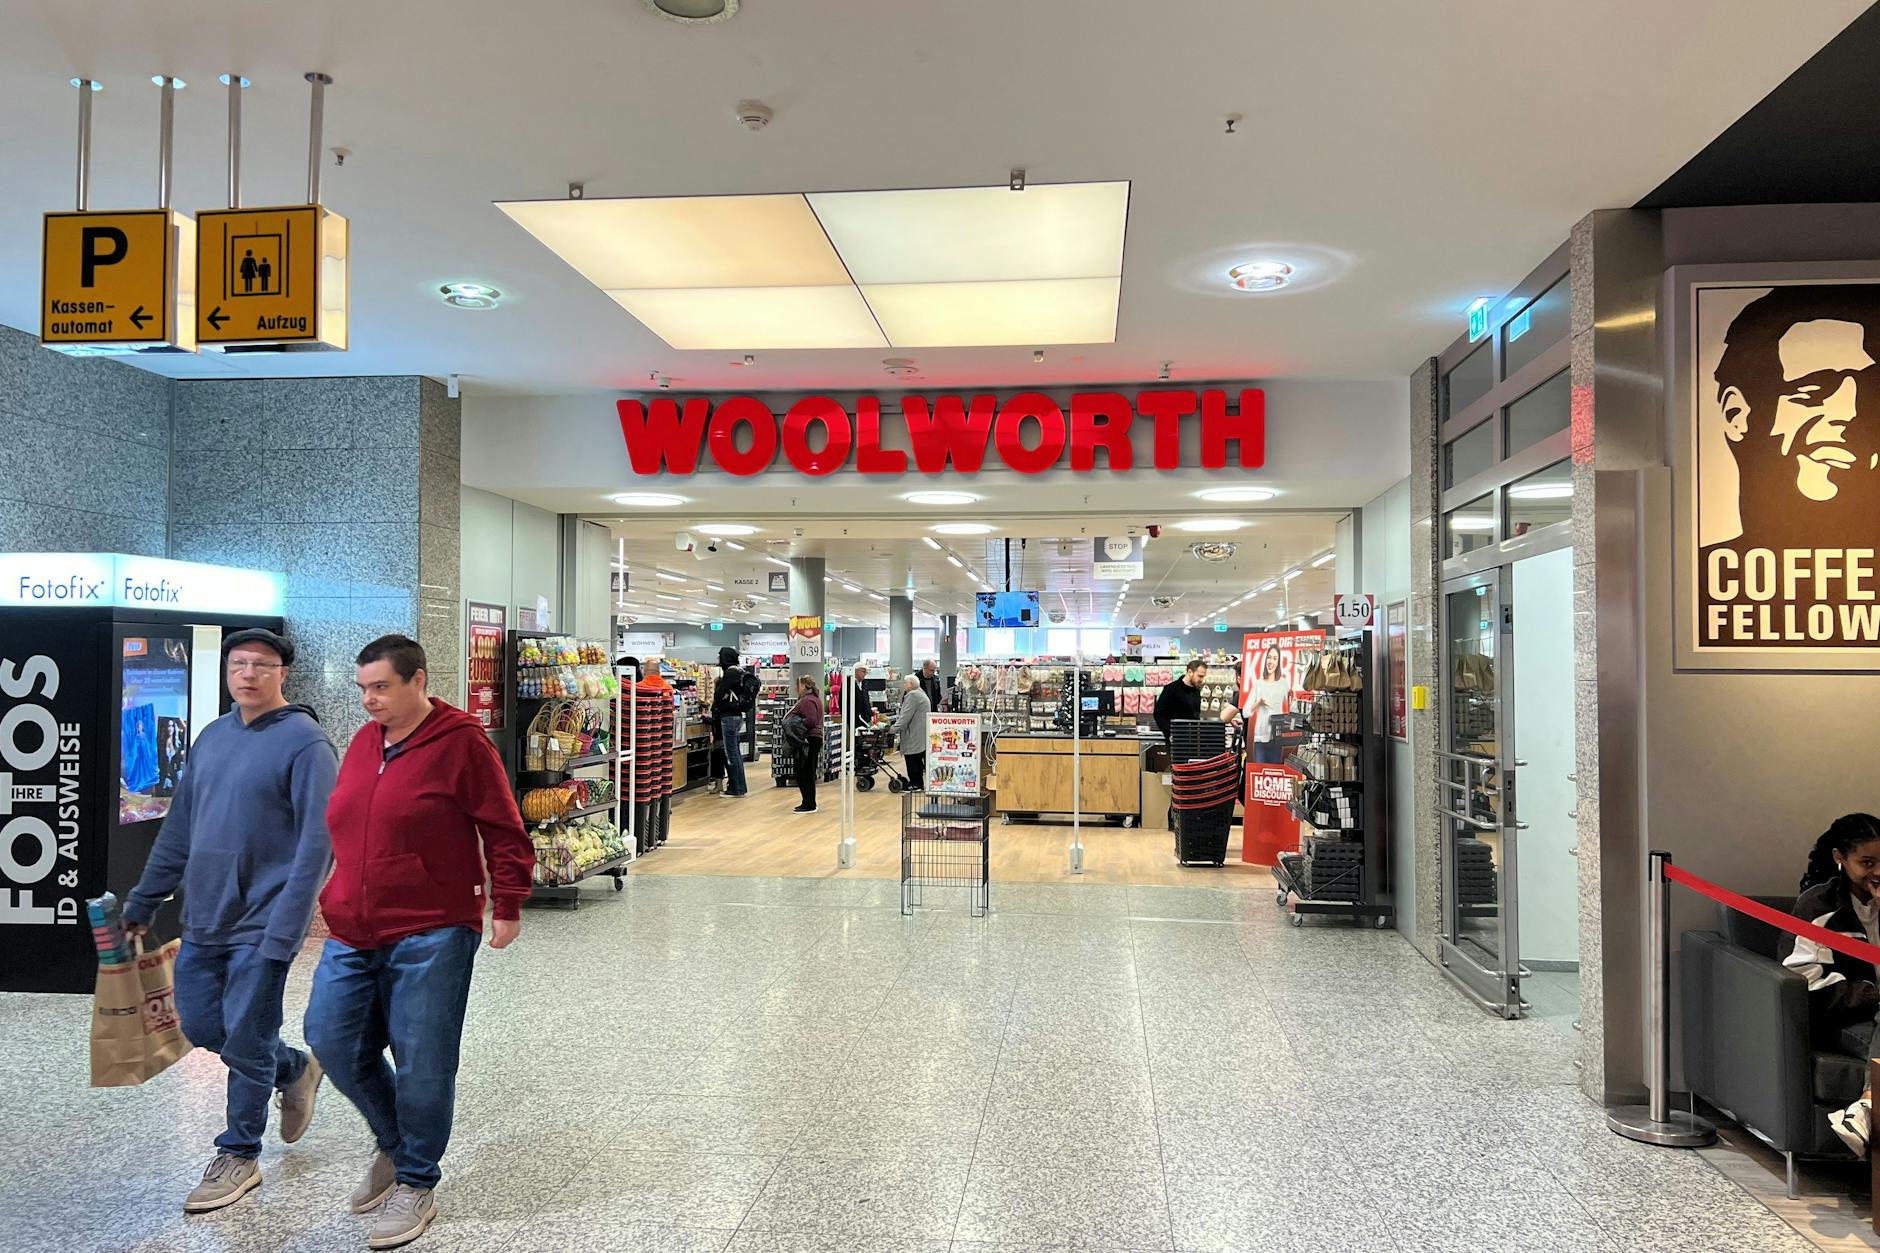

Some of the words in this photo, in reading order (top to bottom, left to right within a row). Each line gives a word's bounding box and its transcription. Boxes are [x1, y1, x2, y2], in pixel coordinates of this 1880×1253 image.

[81, 226, 129, 288] P
[50, 320, 113, 334] automat
[256, 315, 307, 331] Aufzug
[616, 388, 1266, 476] WOOLWORTH
[1707, 547, 1876, 602] COFFE
[20, 575, 100, 599] Fotofix
[124, 578, 179, 602] Fotofix
[1338, 602, 1370, 618] 1.50
[800, 645, 819, 657] 0.39
[1247, 638, 1260, 650] ICH
[1279, 636, 1293, 648] DIR
[0, 655, 60, 925] FOTOS
[58, 723, 80, 860] AUSWEISE
[1254, 776, 1292, 791] HOME
[11, 788, 43, 799] IHRE
[1254, 790, 1292, 800] DISCOUNT
[58, 869, 78, 887] &
[57, 897, 78, 924] ID
